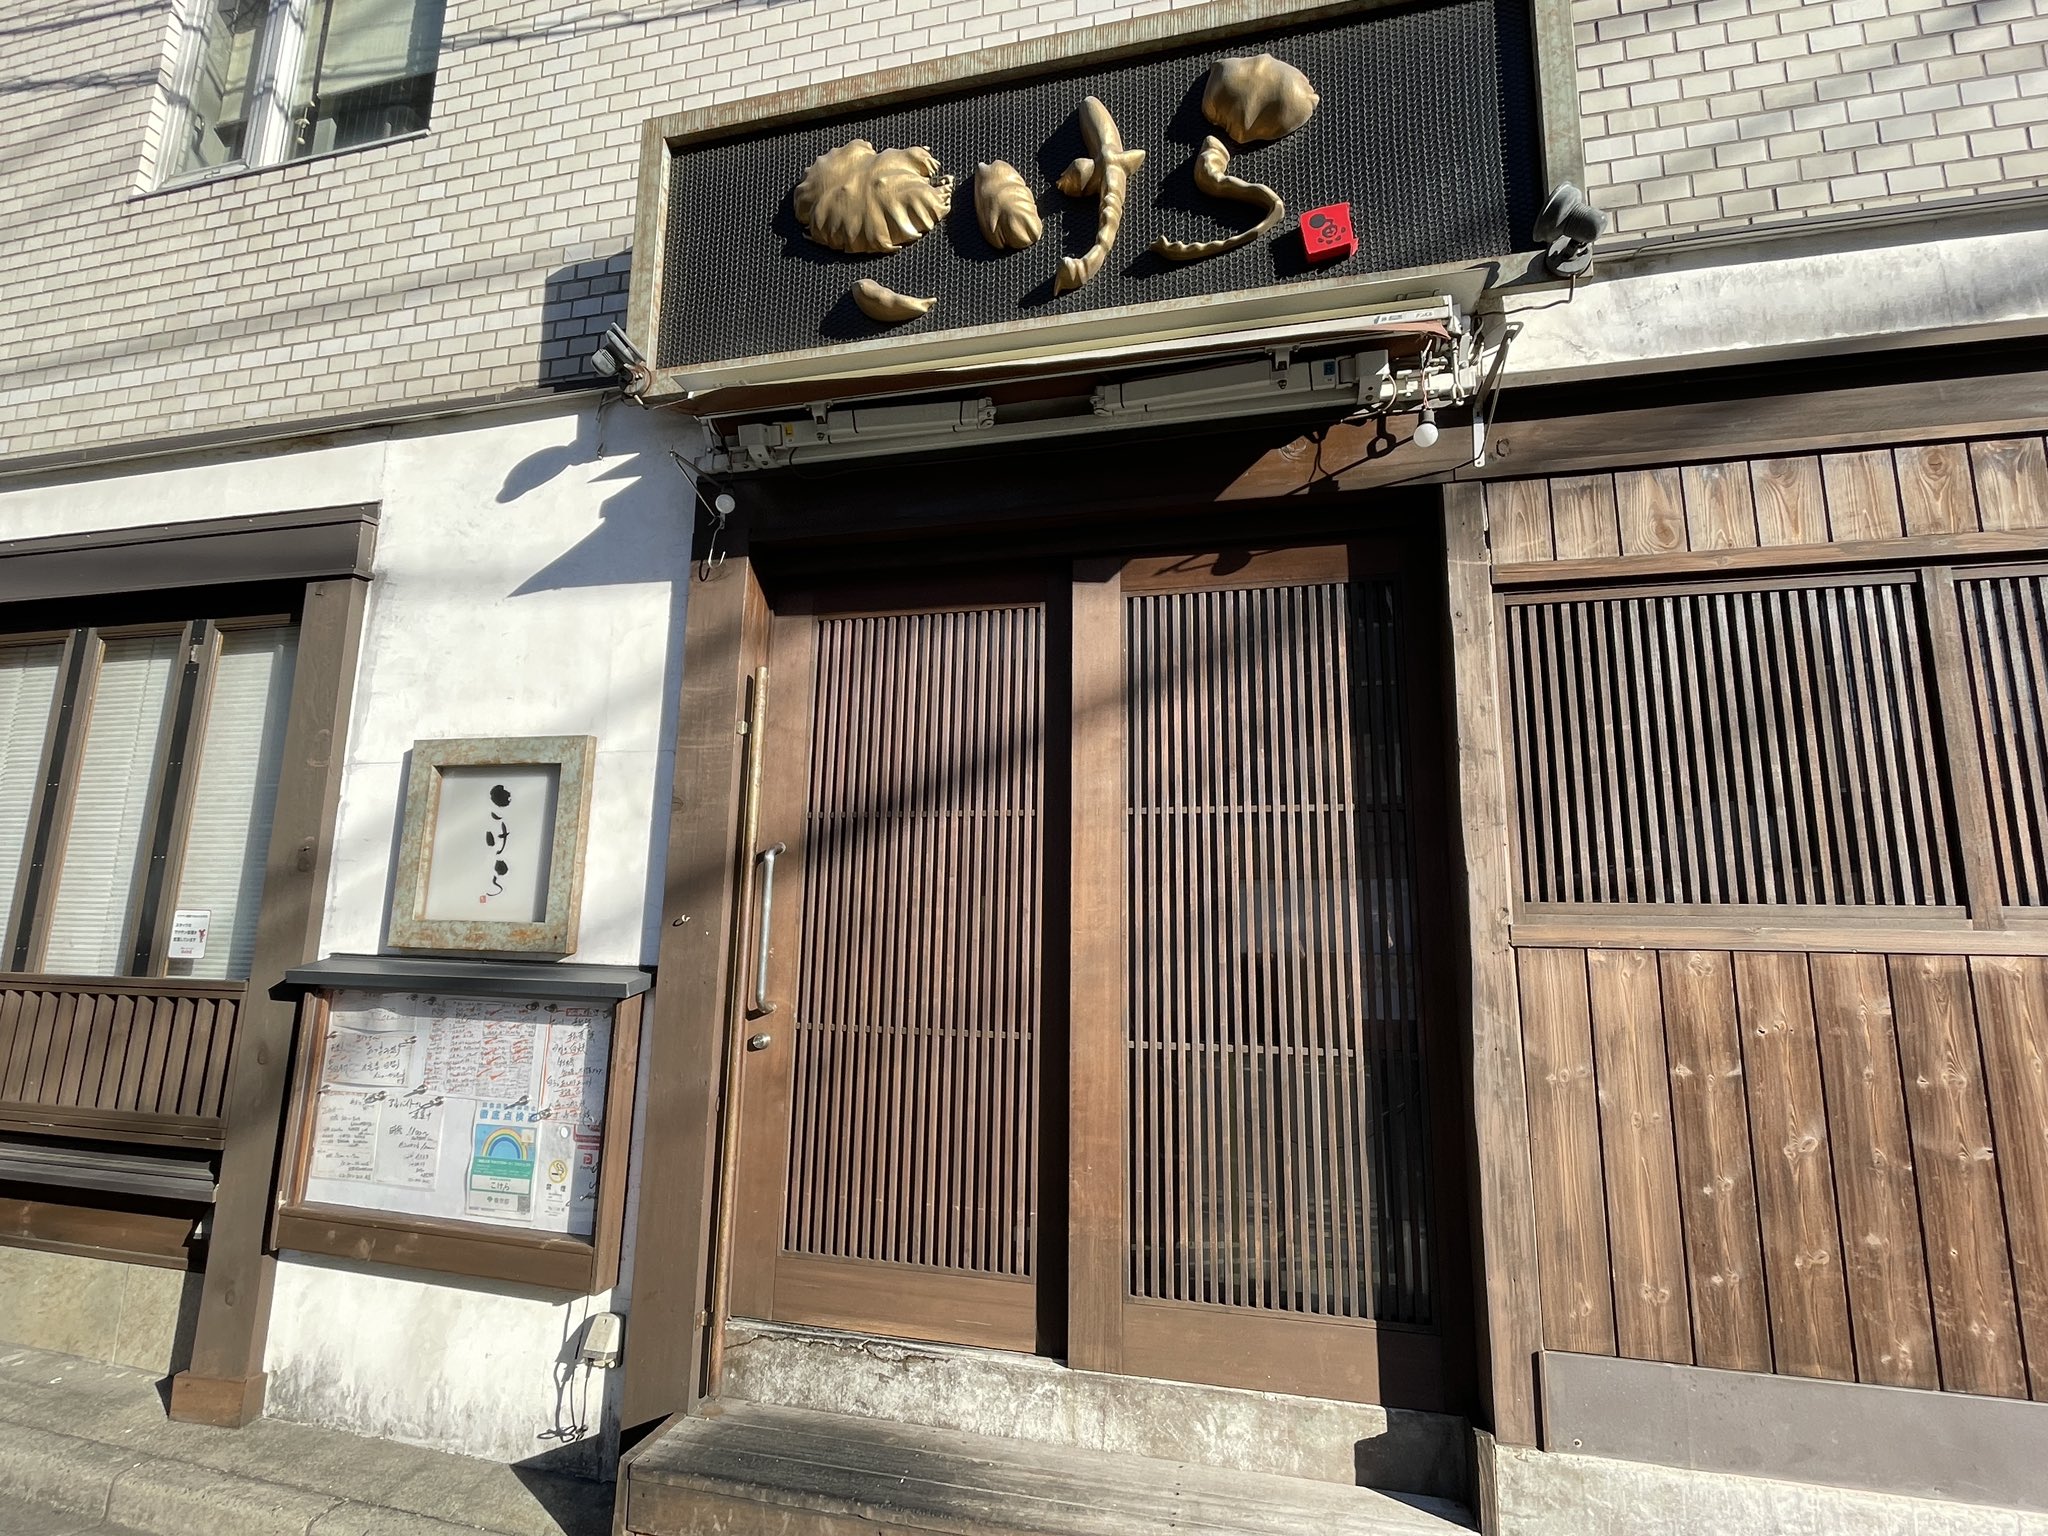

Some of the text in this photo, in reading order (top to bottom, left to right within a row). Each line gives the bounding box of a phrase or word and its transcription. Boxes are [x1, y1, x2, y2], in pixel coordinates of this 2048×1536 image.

[485, 784, 513, 897] こけら
[490, 1181, 511, 1192] こけら
